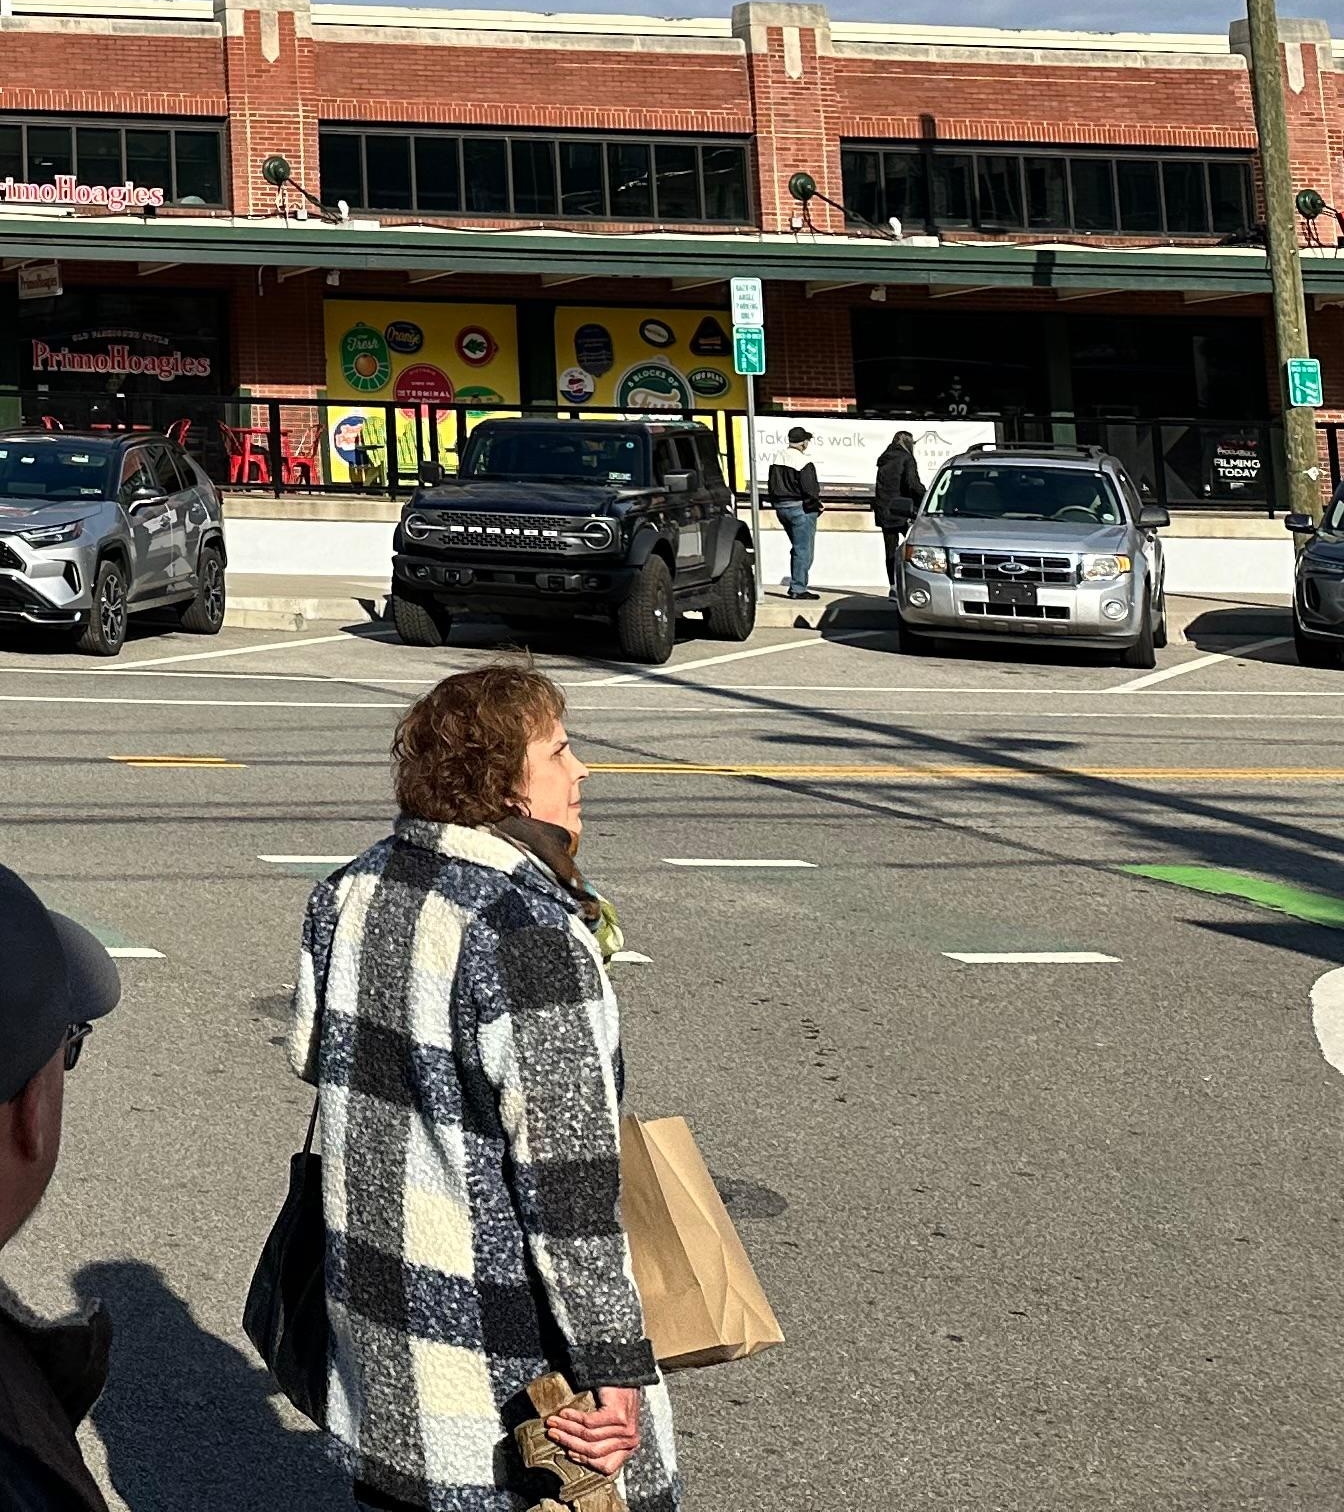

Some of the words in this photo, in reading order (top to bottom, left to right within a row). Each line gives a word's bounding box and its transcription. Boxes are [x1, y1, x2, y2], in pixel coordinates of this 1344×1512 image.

[346, 333, 380, 352] Fresh
[32, 339, 212, 382] PrimoHoagies
[633, 369, 667, 382] BLOCKS
[668, 376, 679, 387] OF
[406, 389, 451, 398] TERMINAL
[829, 433, 866, 448] walk
[1214, 457, 1261, 469] FILMING
[1217, 468, 1258, 478] TODAY
[450, 525, 558, 537] BRONCO
